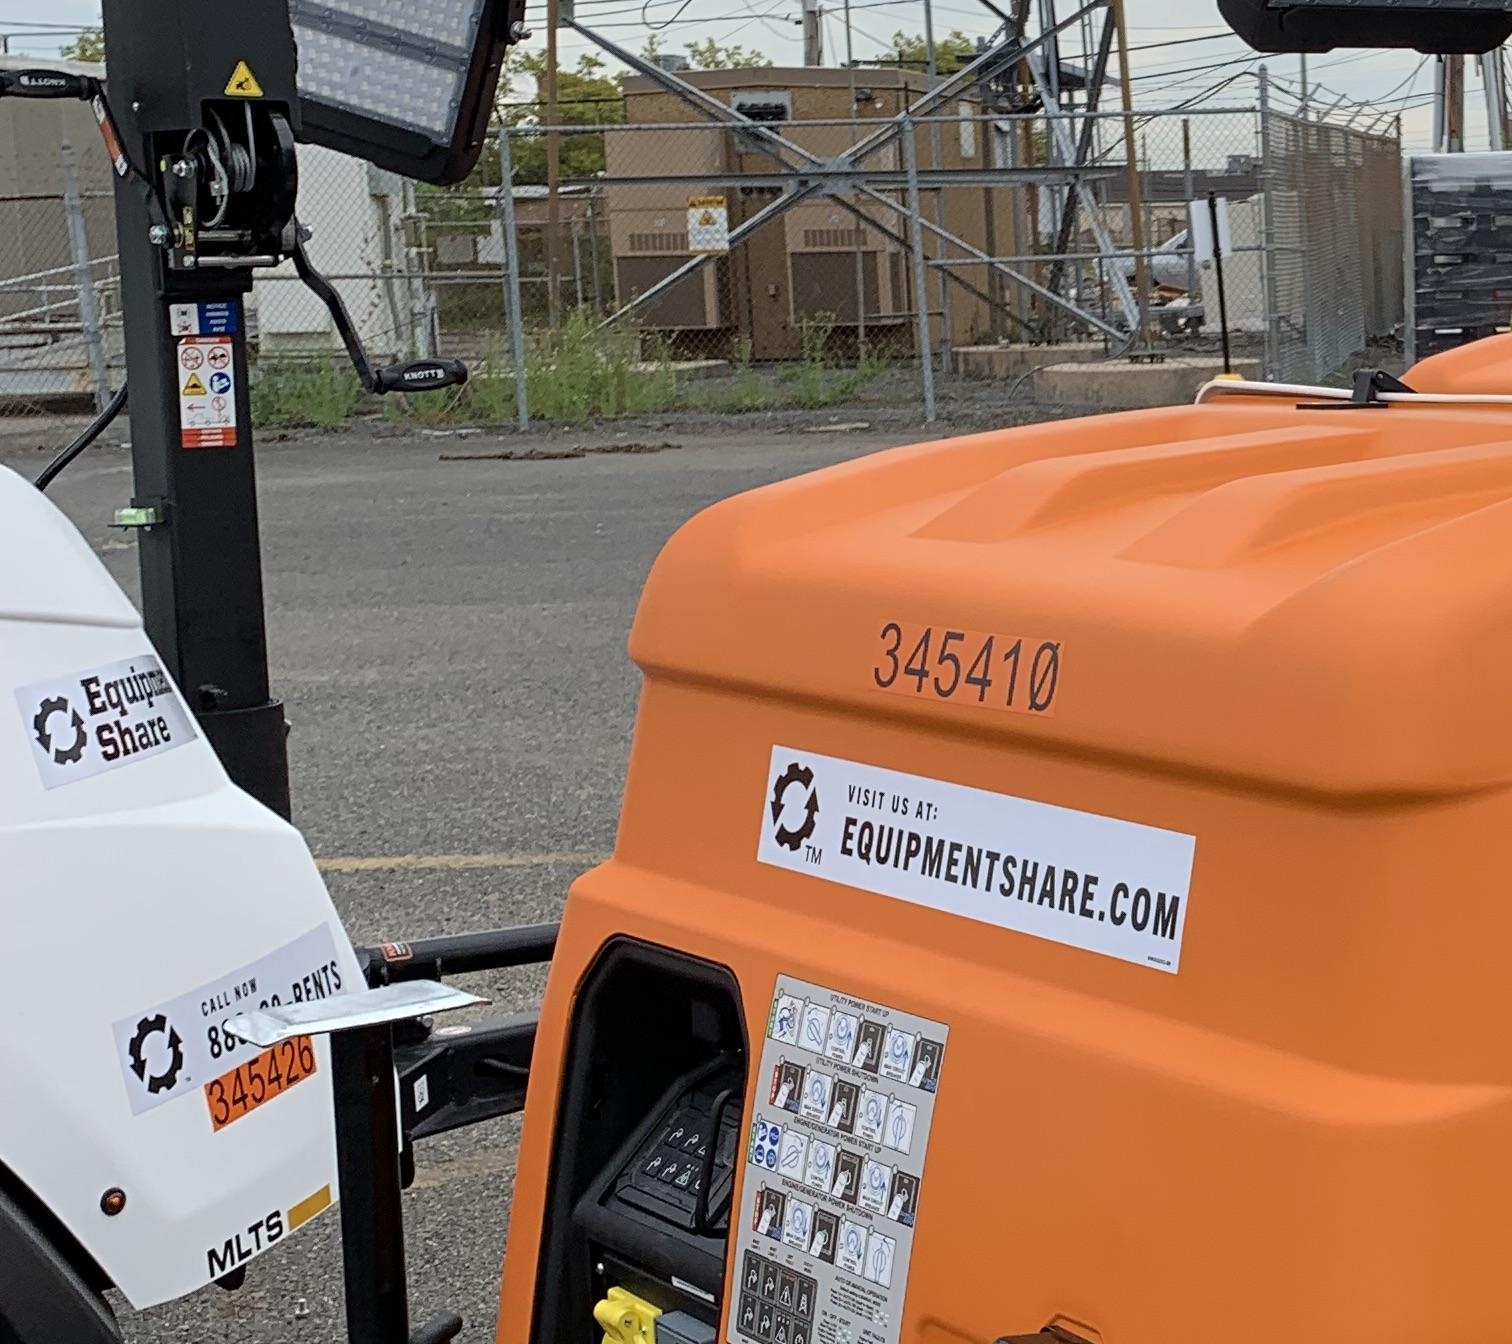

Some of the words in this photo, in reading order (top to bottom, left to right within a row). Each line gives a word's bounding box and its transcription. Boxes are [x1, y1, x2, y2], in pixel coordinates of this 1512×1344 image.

[403, 369, 437, 381] KNOTT
[874, 622, 1061, 712] 345410
[80, 666, 172, 716] Equip
[96, 716, 171, 761] Share
[848, 784, 885, 811] VISIT
[891, 795, 909, 816] US
[915, 800, 938, 822] AT:
[805, 845, 823, 865] TM
[840, 816, 1180, 941] EQUIPMENTSHARE.COM
[201, 990, 231, 1017] CALL
[234, 977, 257, 1001] NOW
[208, 1035, 314, 1126] 345426
[207, 1210, 283, 1278] MLTS
